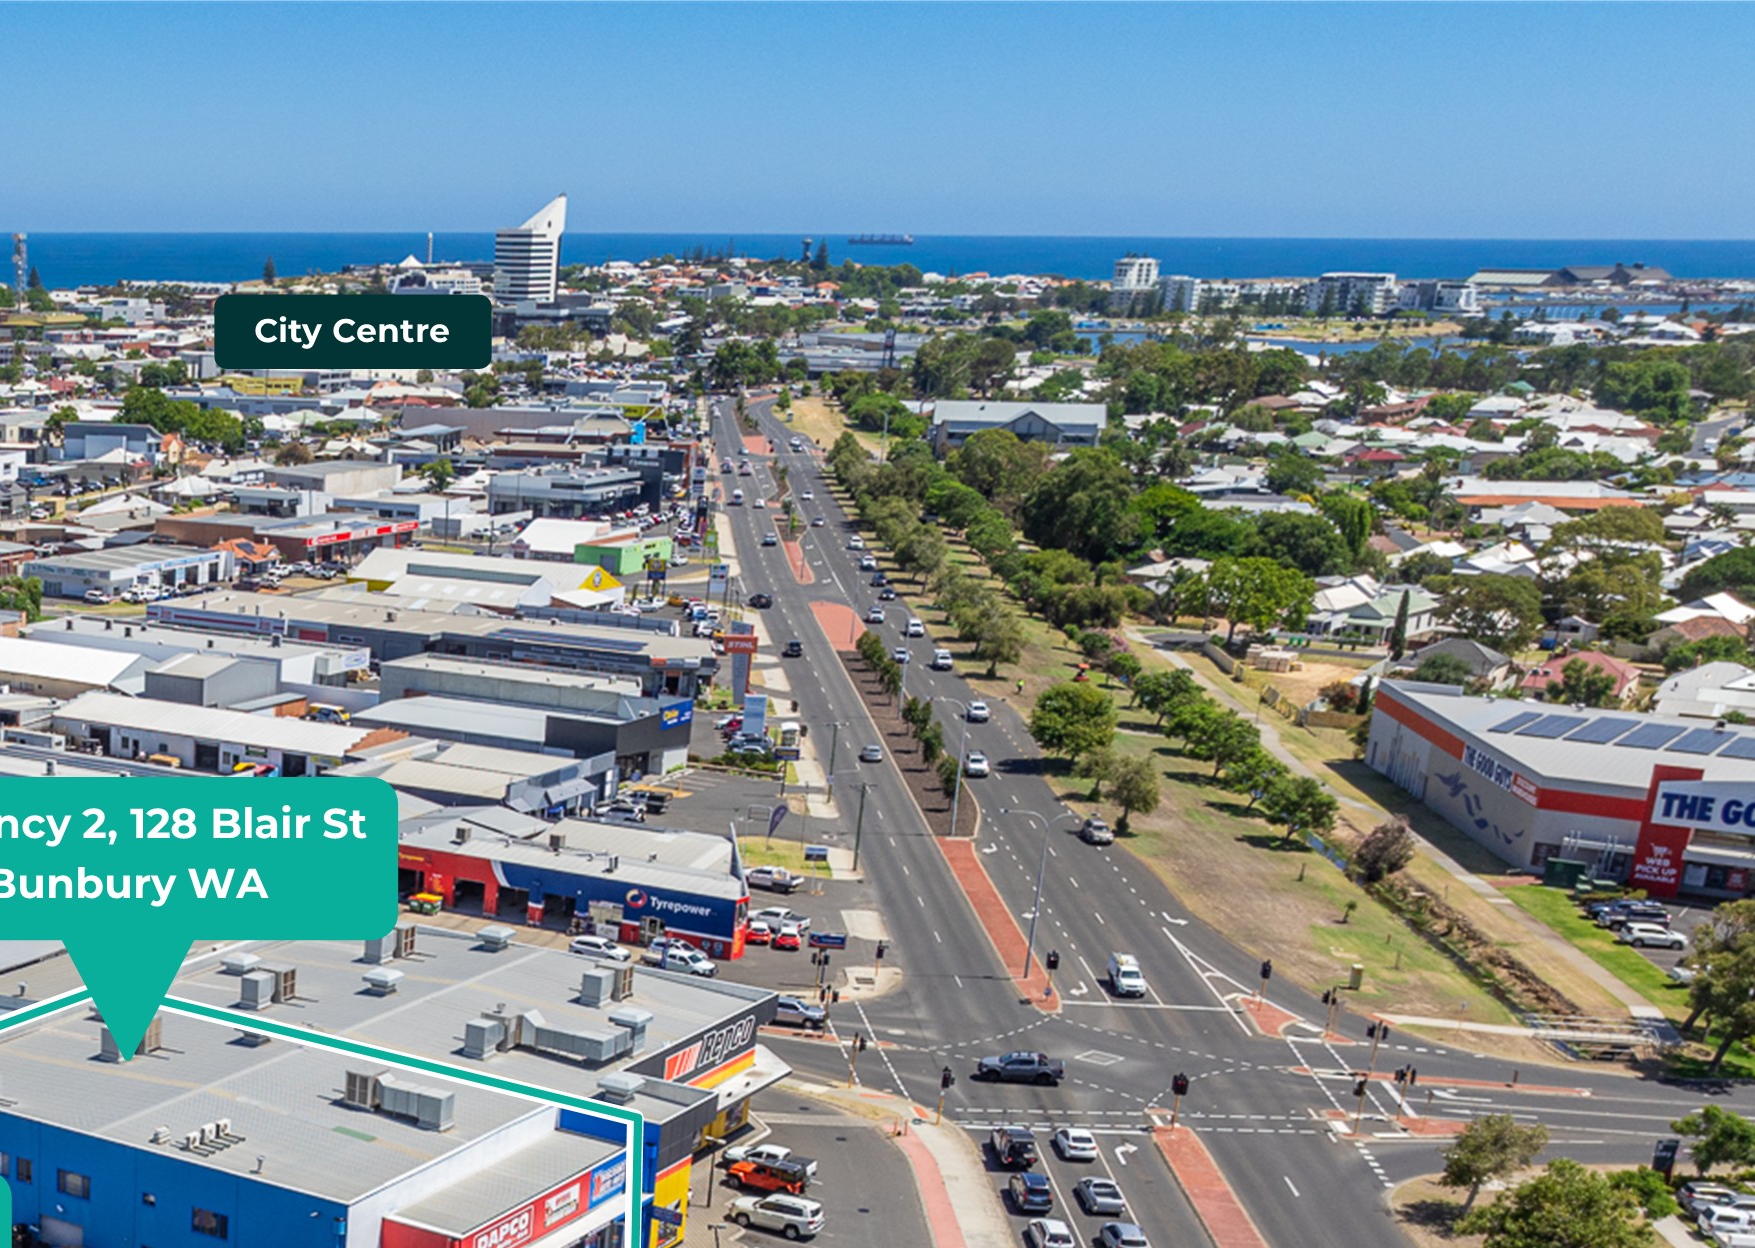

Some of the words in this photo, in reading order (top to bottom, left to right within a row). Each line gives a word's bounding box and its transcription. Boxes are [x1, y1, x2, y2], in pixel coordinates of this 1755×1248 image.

[1661, 791, 1716, 822] THE
[649, 896, 712, 917] Tyrepower
[697, 1015, 756, 1068] Repco
